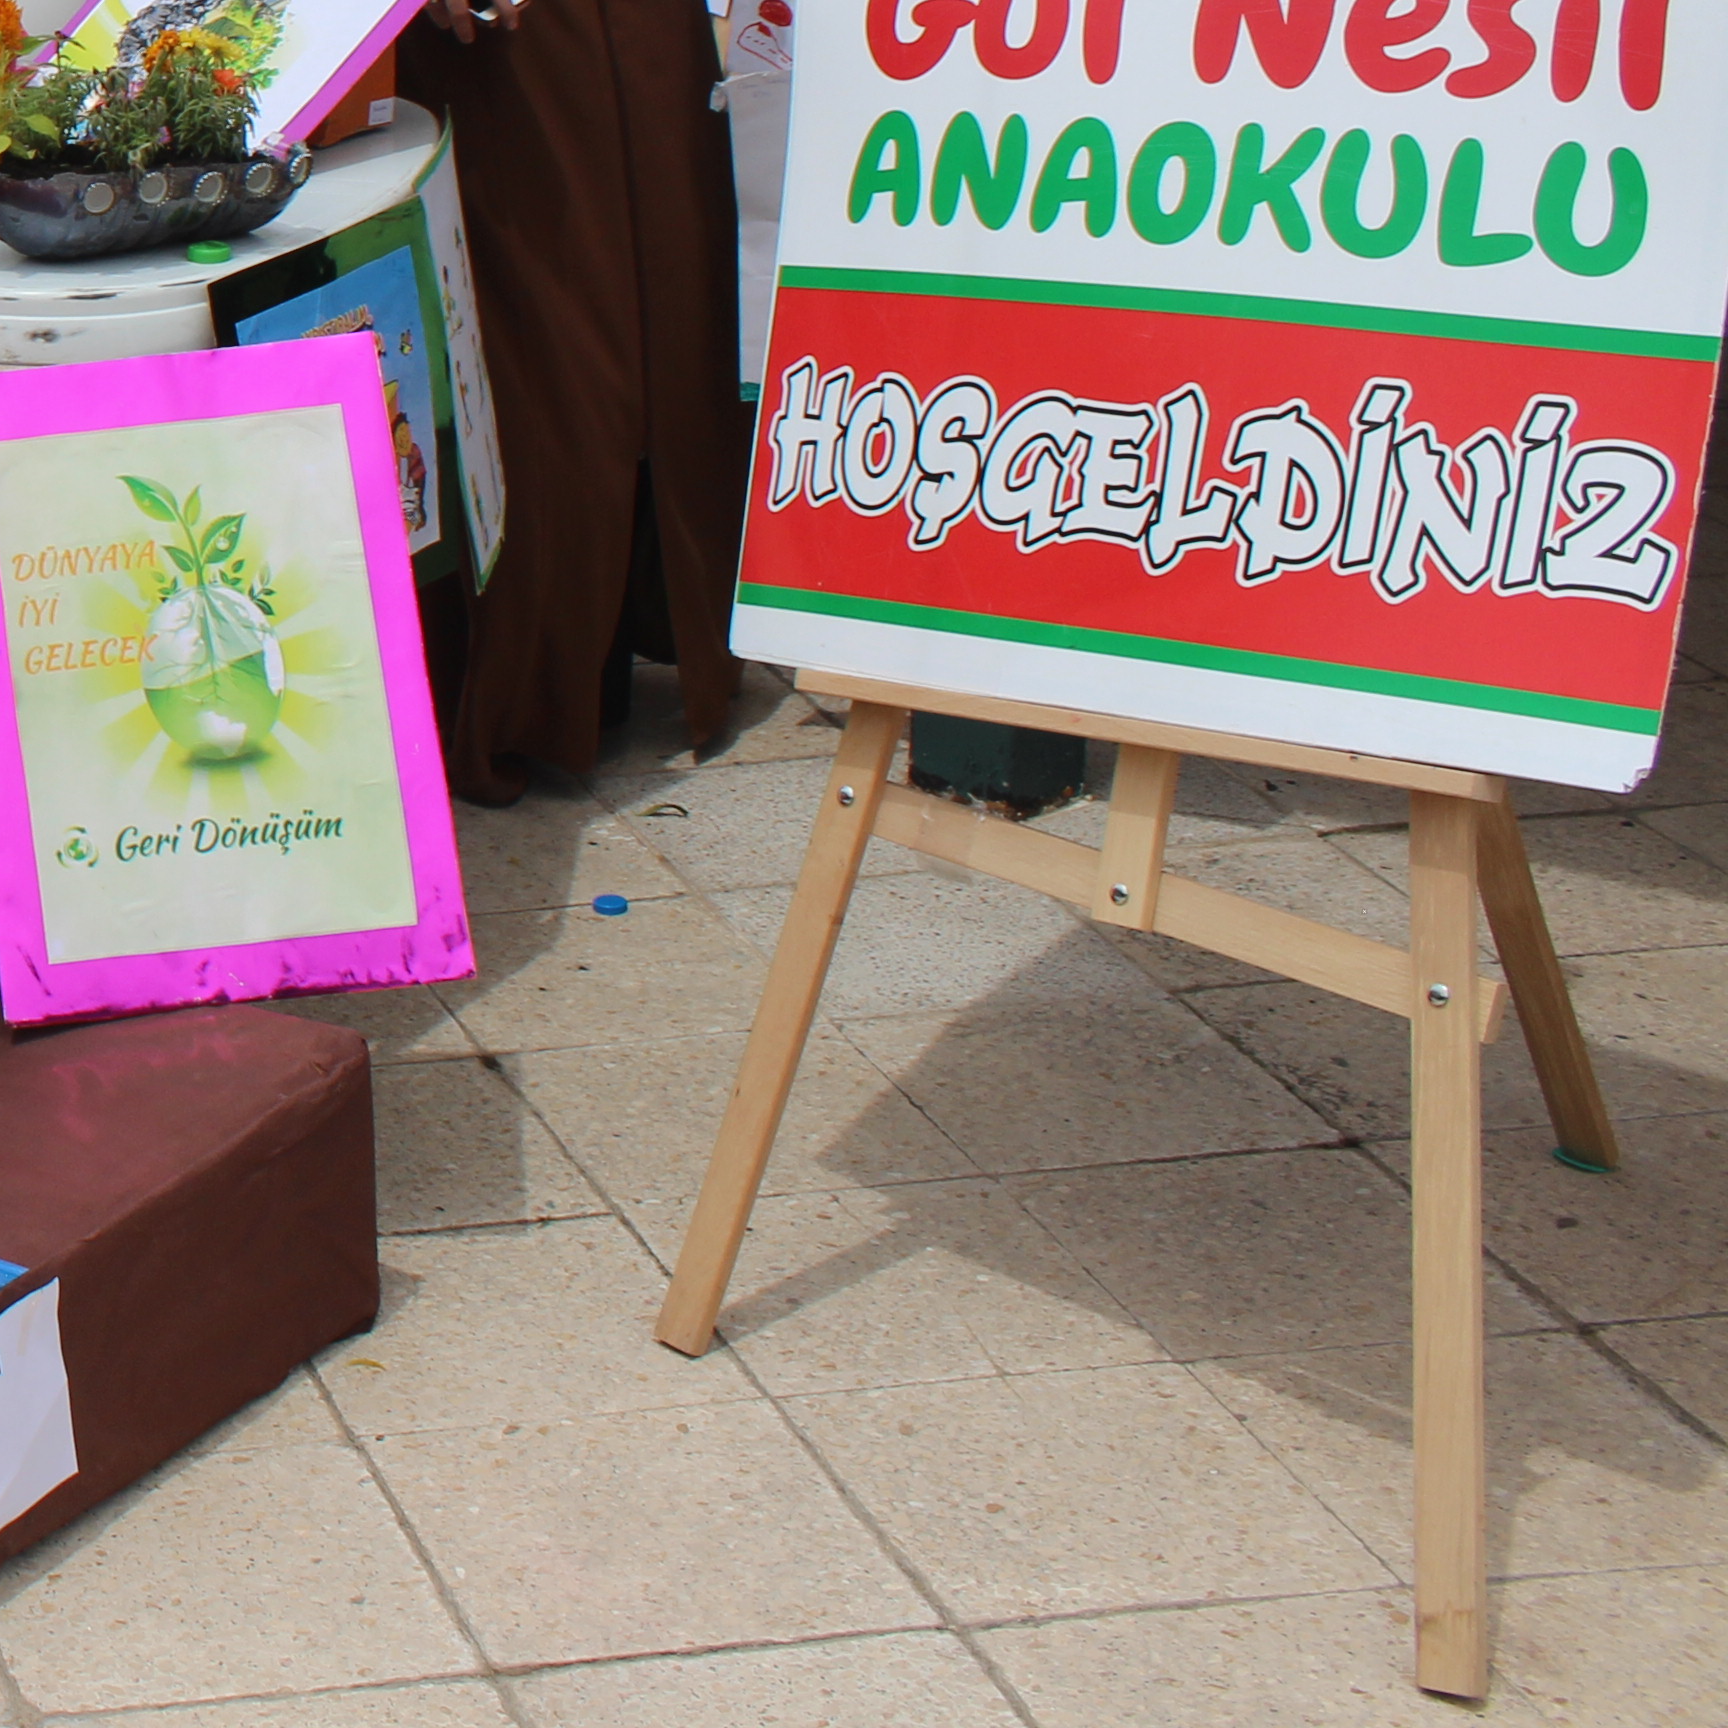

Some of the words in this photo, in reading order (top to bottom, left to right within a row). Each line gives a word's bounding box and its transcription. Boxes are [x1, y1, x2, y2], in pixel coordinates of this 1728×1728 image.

[847, 109, 1649, 277] ANAOKULU
[767, 356, 1679, 613] HOŞGELDİNİZ
[11, 538, 158, 583] DÜNYAYA
[18, 592, 59, 628] İYİ
[24, 632, 159, 676] GELECEK
[115, 822, 181, 864] Geri
[193, 808, 344, 855] Dönüşüm
